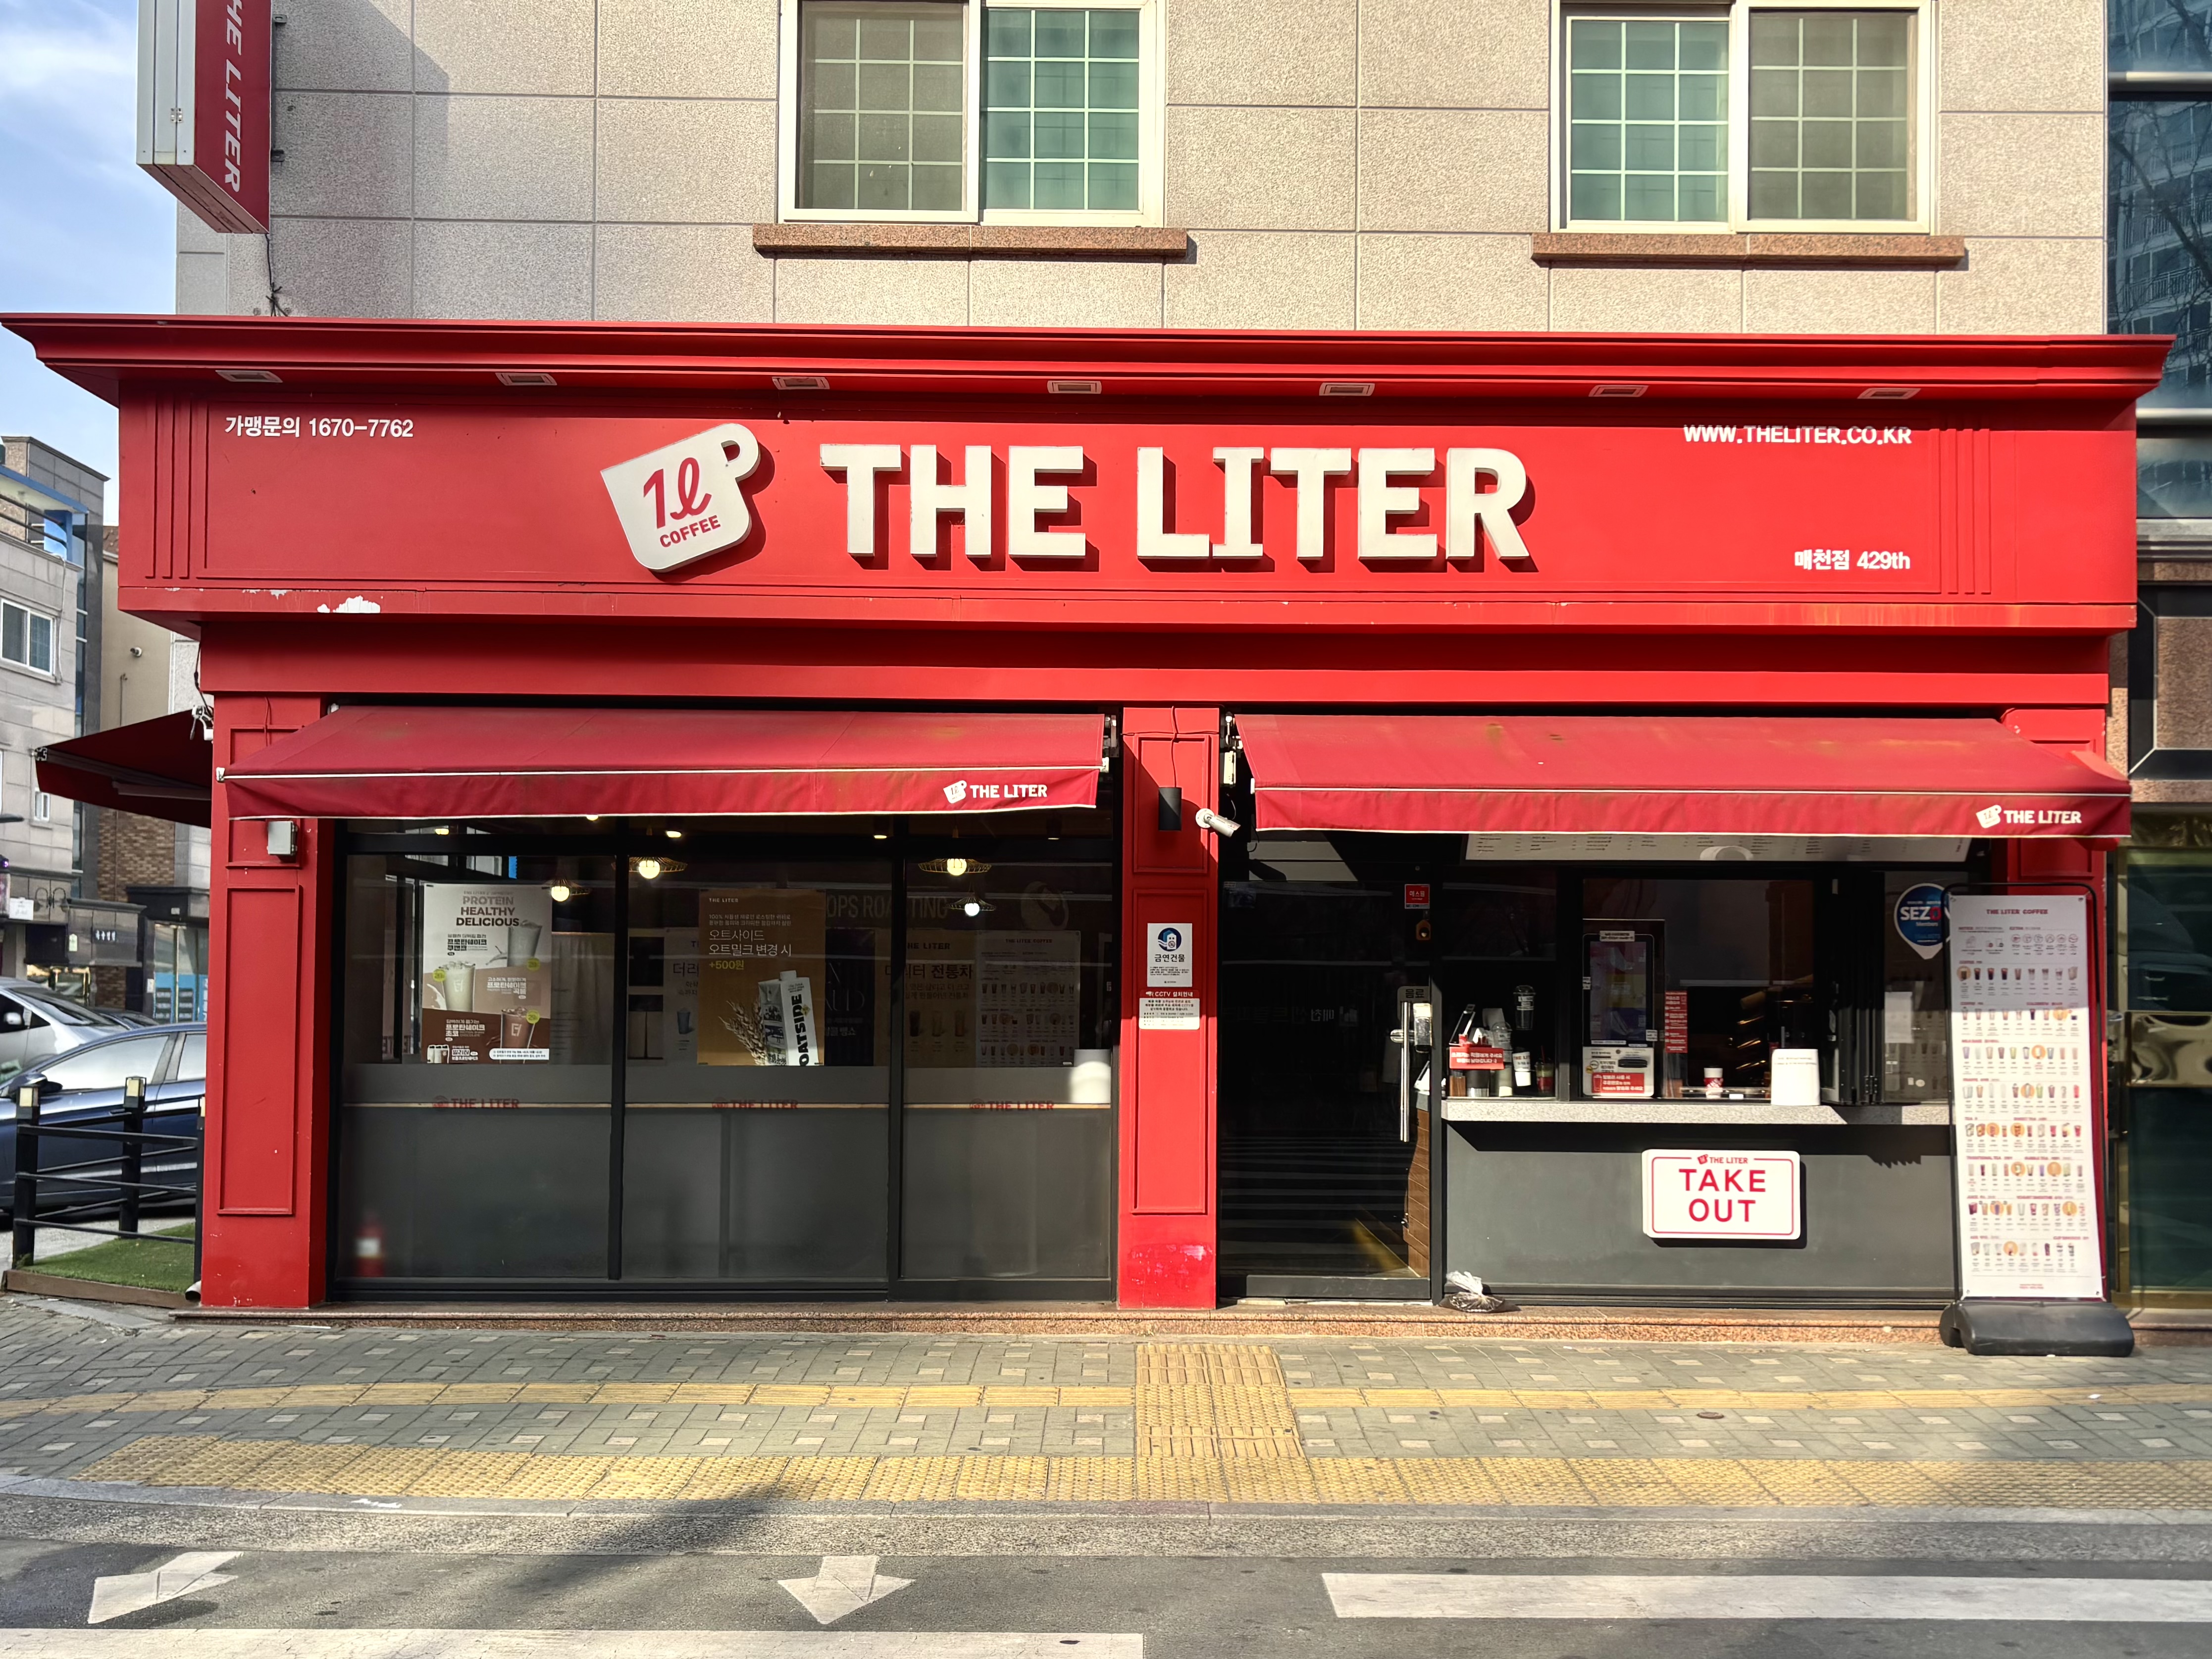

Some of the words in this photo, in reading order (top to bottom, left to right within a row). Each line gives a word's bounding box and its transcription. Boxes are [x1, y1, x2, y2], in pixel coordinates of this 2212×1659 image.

[225, 59, 242, 192] LITER
[225, 415, 300, 437] 가맹문의
[309, 418, 413, 437] 1670-7762
[1684, 424, 1912, 445] WWW.THELITER.CO.KR
[820, 444, 1086, 559] THE
[1137, 447, 1529, 560] LITER
[660, 515, 720, 547] COFFEE
[1795, 549, 1850, 570] 매천점
[1857, 551, 1910, 570] 429th
[970, 785, 1000, 798] THE
[1004, 784, 1047, 798] LITER
[2004, 810, 2035, 823] THE
[2039, 810, 2082, 824] LITER
[463, 896, 514, 905] PROTEIN
[456, 918, 519, 926] DELICIOUS
[709, 930, 765, 941] 오트사이드
[709, 943, 754, 956] 오트밀크
[756, 944, 777, 956] 변경
[781, 944, 791, 957] 시
[709, 960, 744, 970] +500원
[1154, 954, 1185, 962] 금연건물
[673, 962, 699, 977] 더리
[931, 964, 973, 979] 전통차
[1405, 988, 1425, 999] 음료
[511, 1023, 521, 1036] 더
[791, 994, 809, 1066] OATSIDE
[451, 1098, 477, 1109] THE
[482, 1098, 519, 1109] LITER
[987, 1100, 1013, 1111] THE
[1017, 1100, 1054, 1111] LITER
[1679, 1169, 1766, 1192] TAKE
[1689, 1198, 1756, 1222] OUT
